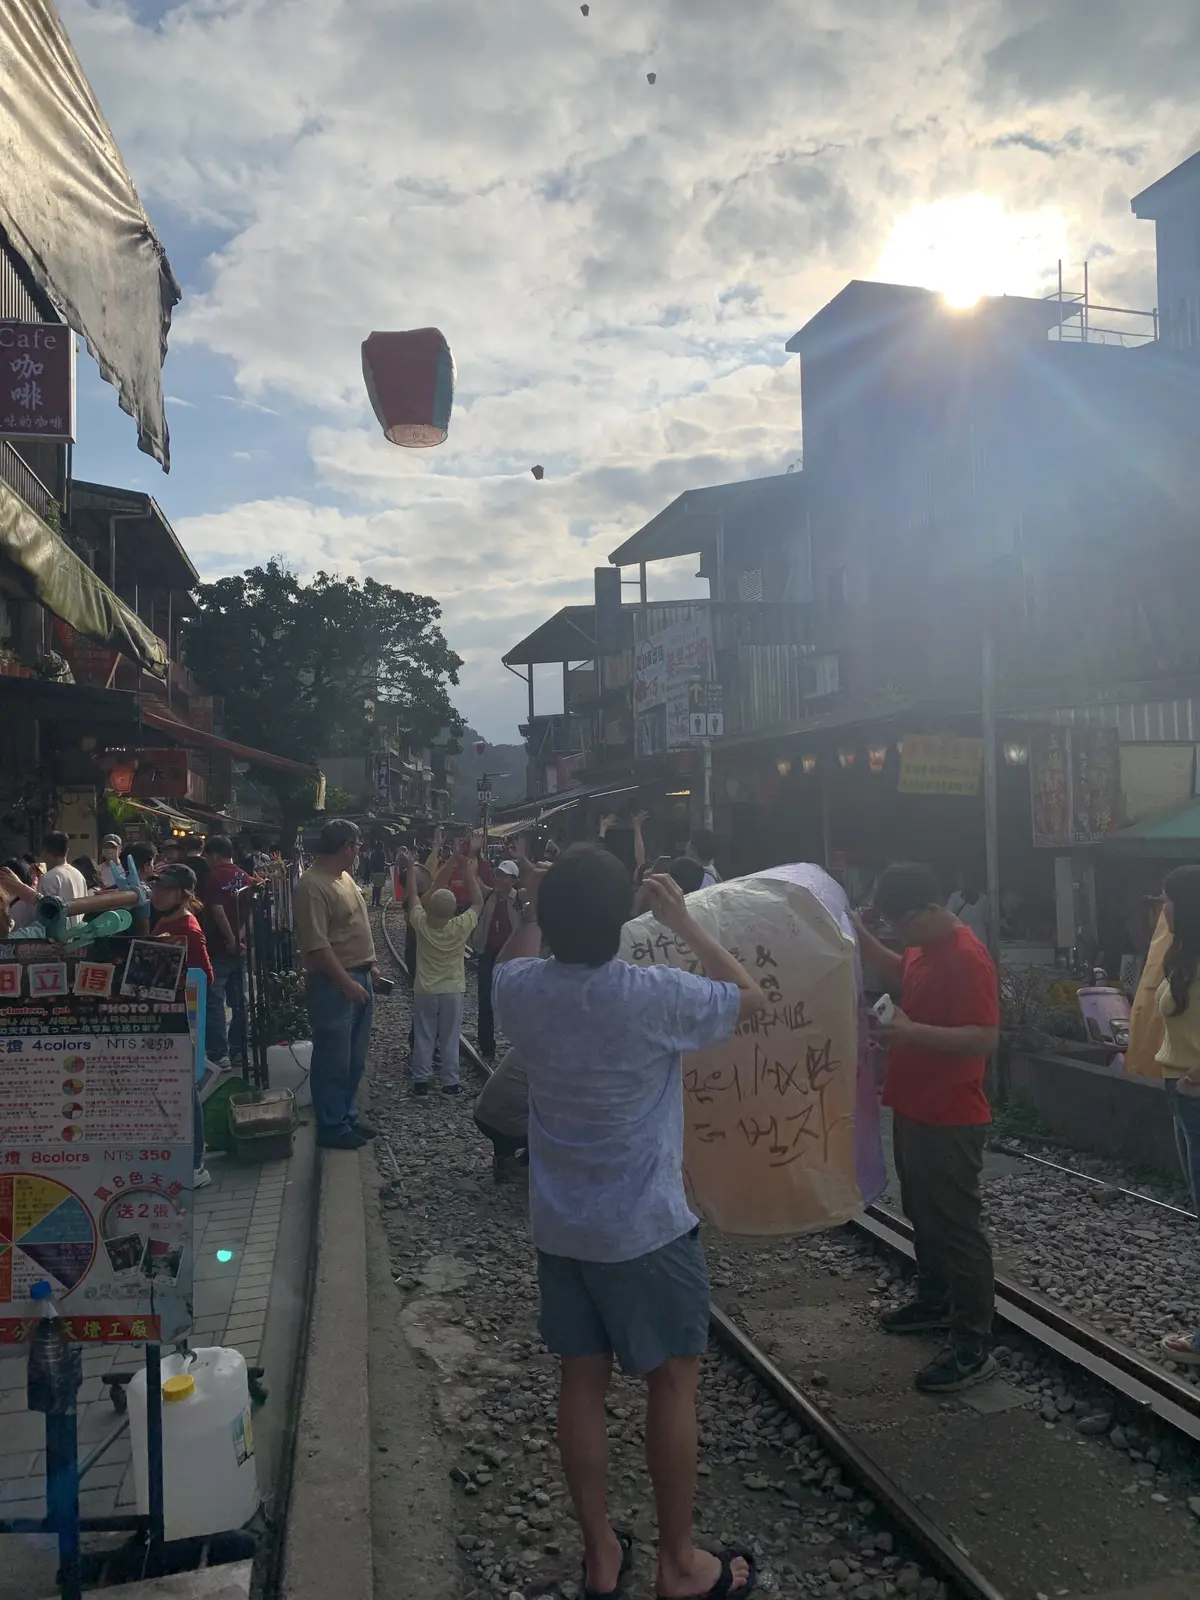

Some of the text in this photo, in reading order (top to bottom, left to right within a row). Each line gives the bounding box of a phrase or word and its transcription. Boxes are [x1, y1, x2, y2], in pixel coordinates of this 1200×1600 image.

[0, 328, 57, 350] Cafe
[9, 353, 44, 411] 咖啡
[0, 413, 63, 431] 味的咖啡
[98, 1003, 149, 1014] PHOTO
[153, 1003, 186, 1013] FREE
[0, 1038, 24, 1054] 燈
[32, 1039, 92, 1052] 4colors
[0, 1150, 21, 1165] 燈
[31, 1150, 90, 1163] 8colors
[138, 1149, 172, 1162] 350
[116, 1202, 170, 1220] 送2張
